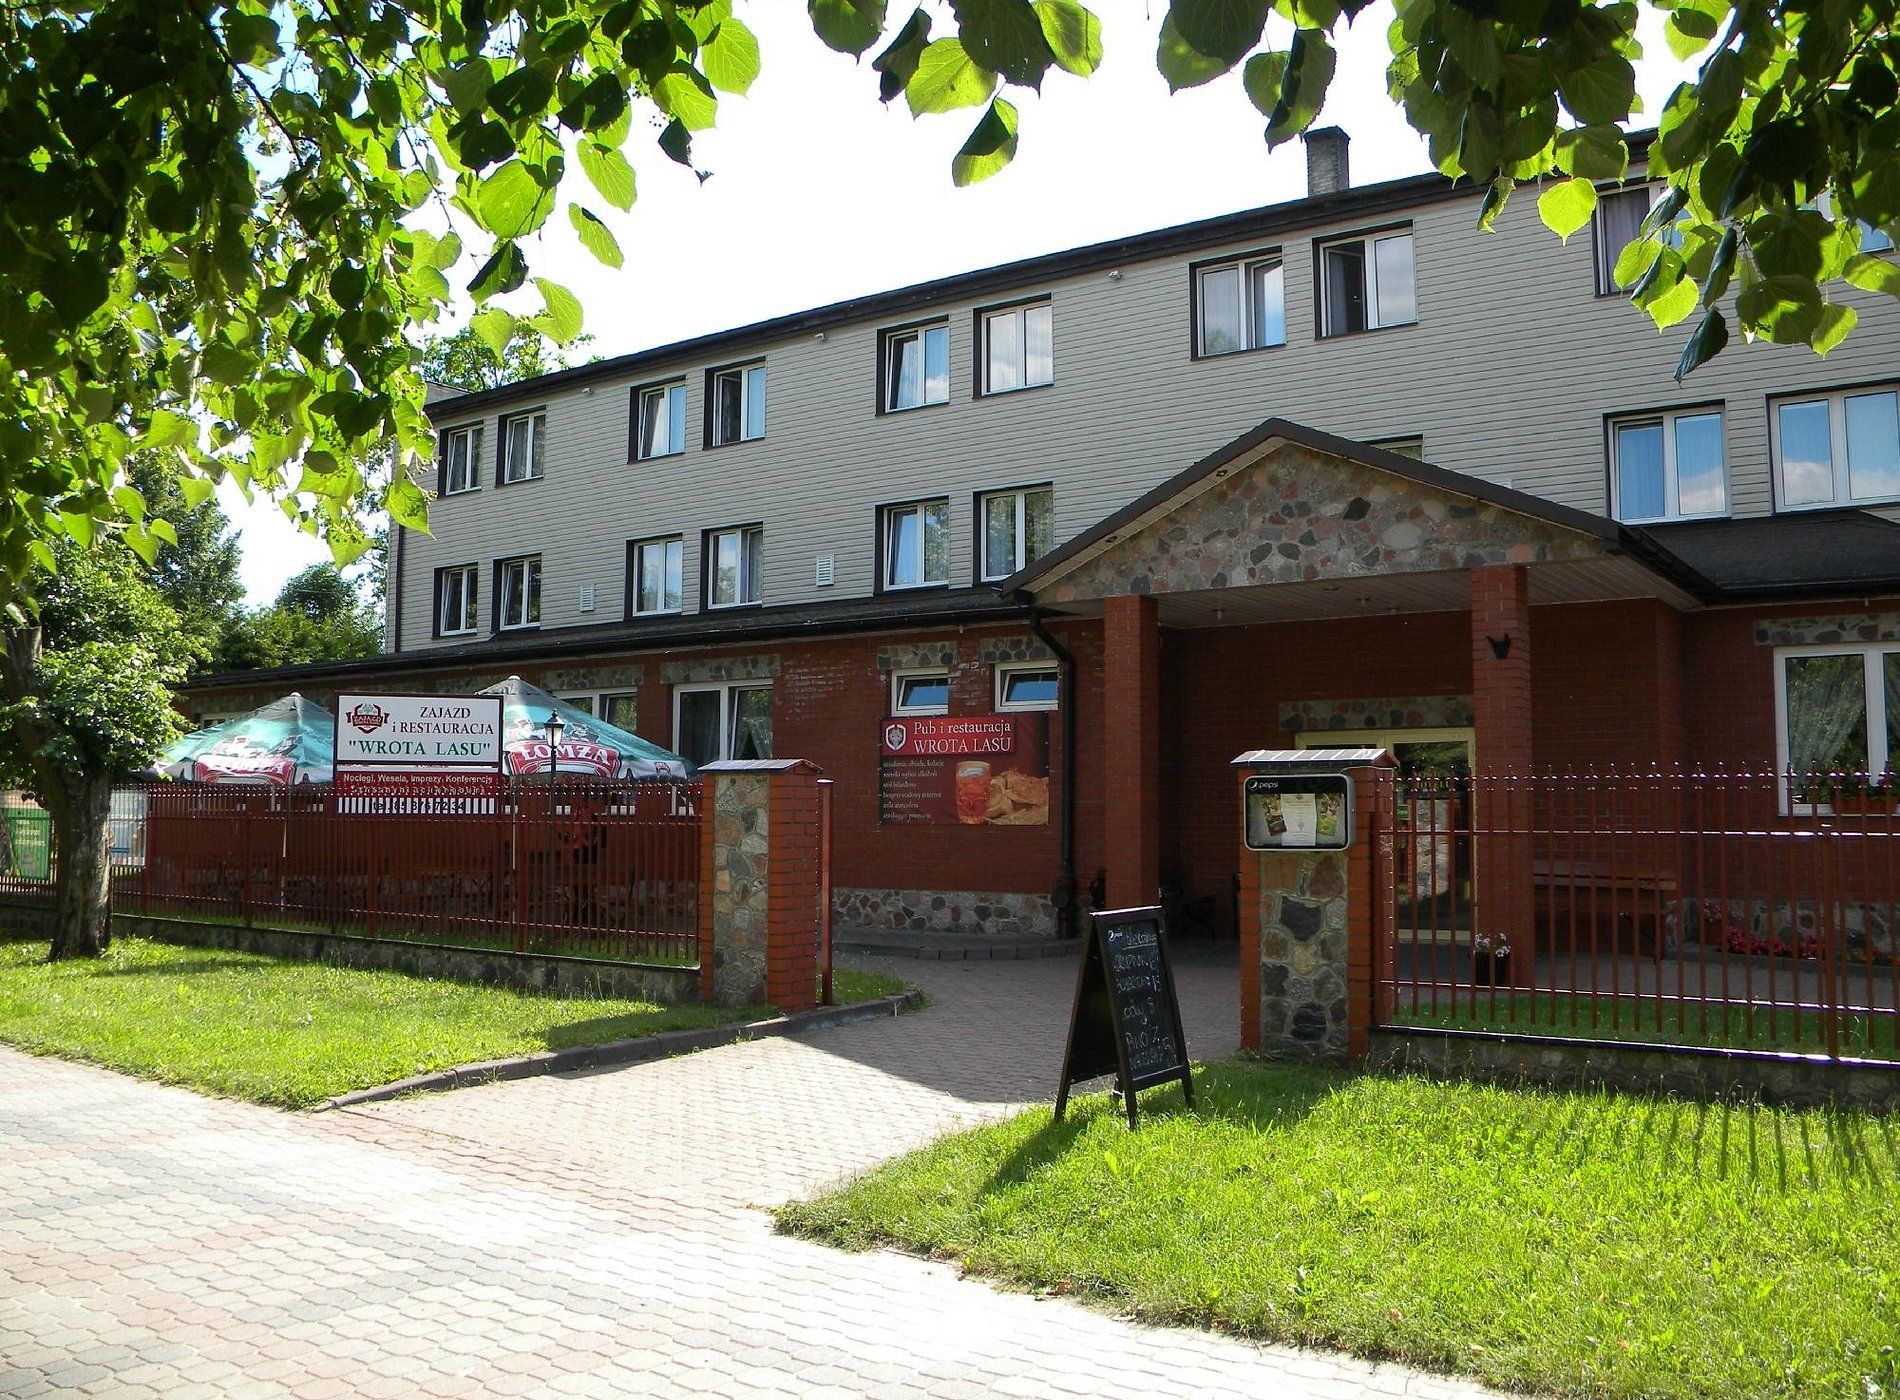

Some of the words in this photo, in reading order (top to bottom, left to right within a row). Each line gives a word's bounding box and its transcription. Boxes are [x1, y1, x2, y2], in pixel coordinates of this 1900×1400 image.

[420, 706, 471, 719] ZAJAZD
[391, 721, 396, 733] i
[400, 721, 494, 735] RESTAURACJA
[914, 721, 936, 735] Pub
[940, 723, 944, 734] i
[948, 719, 1012, 737] restauracja
[349, 740, 426, 755] "WROTA
[435, 741, 491, 756] LASU"
[914, 738, 968, 754] WROTA
[974, 737, 1012, 752] LASU
[1259, 781, 1279, 789] pepsi
